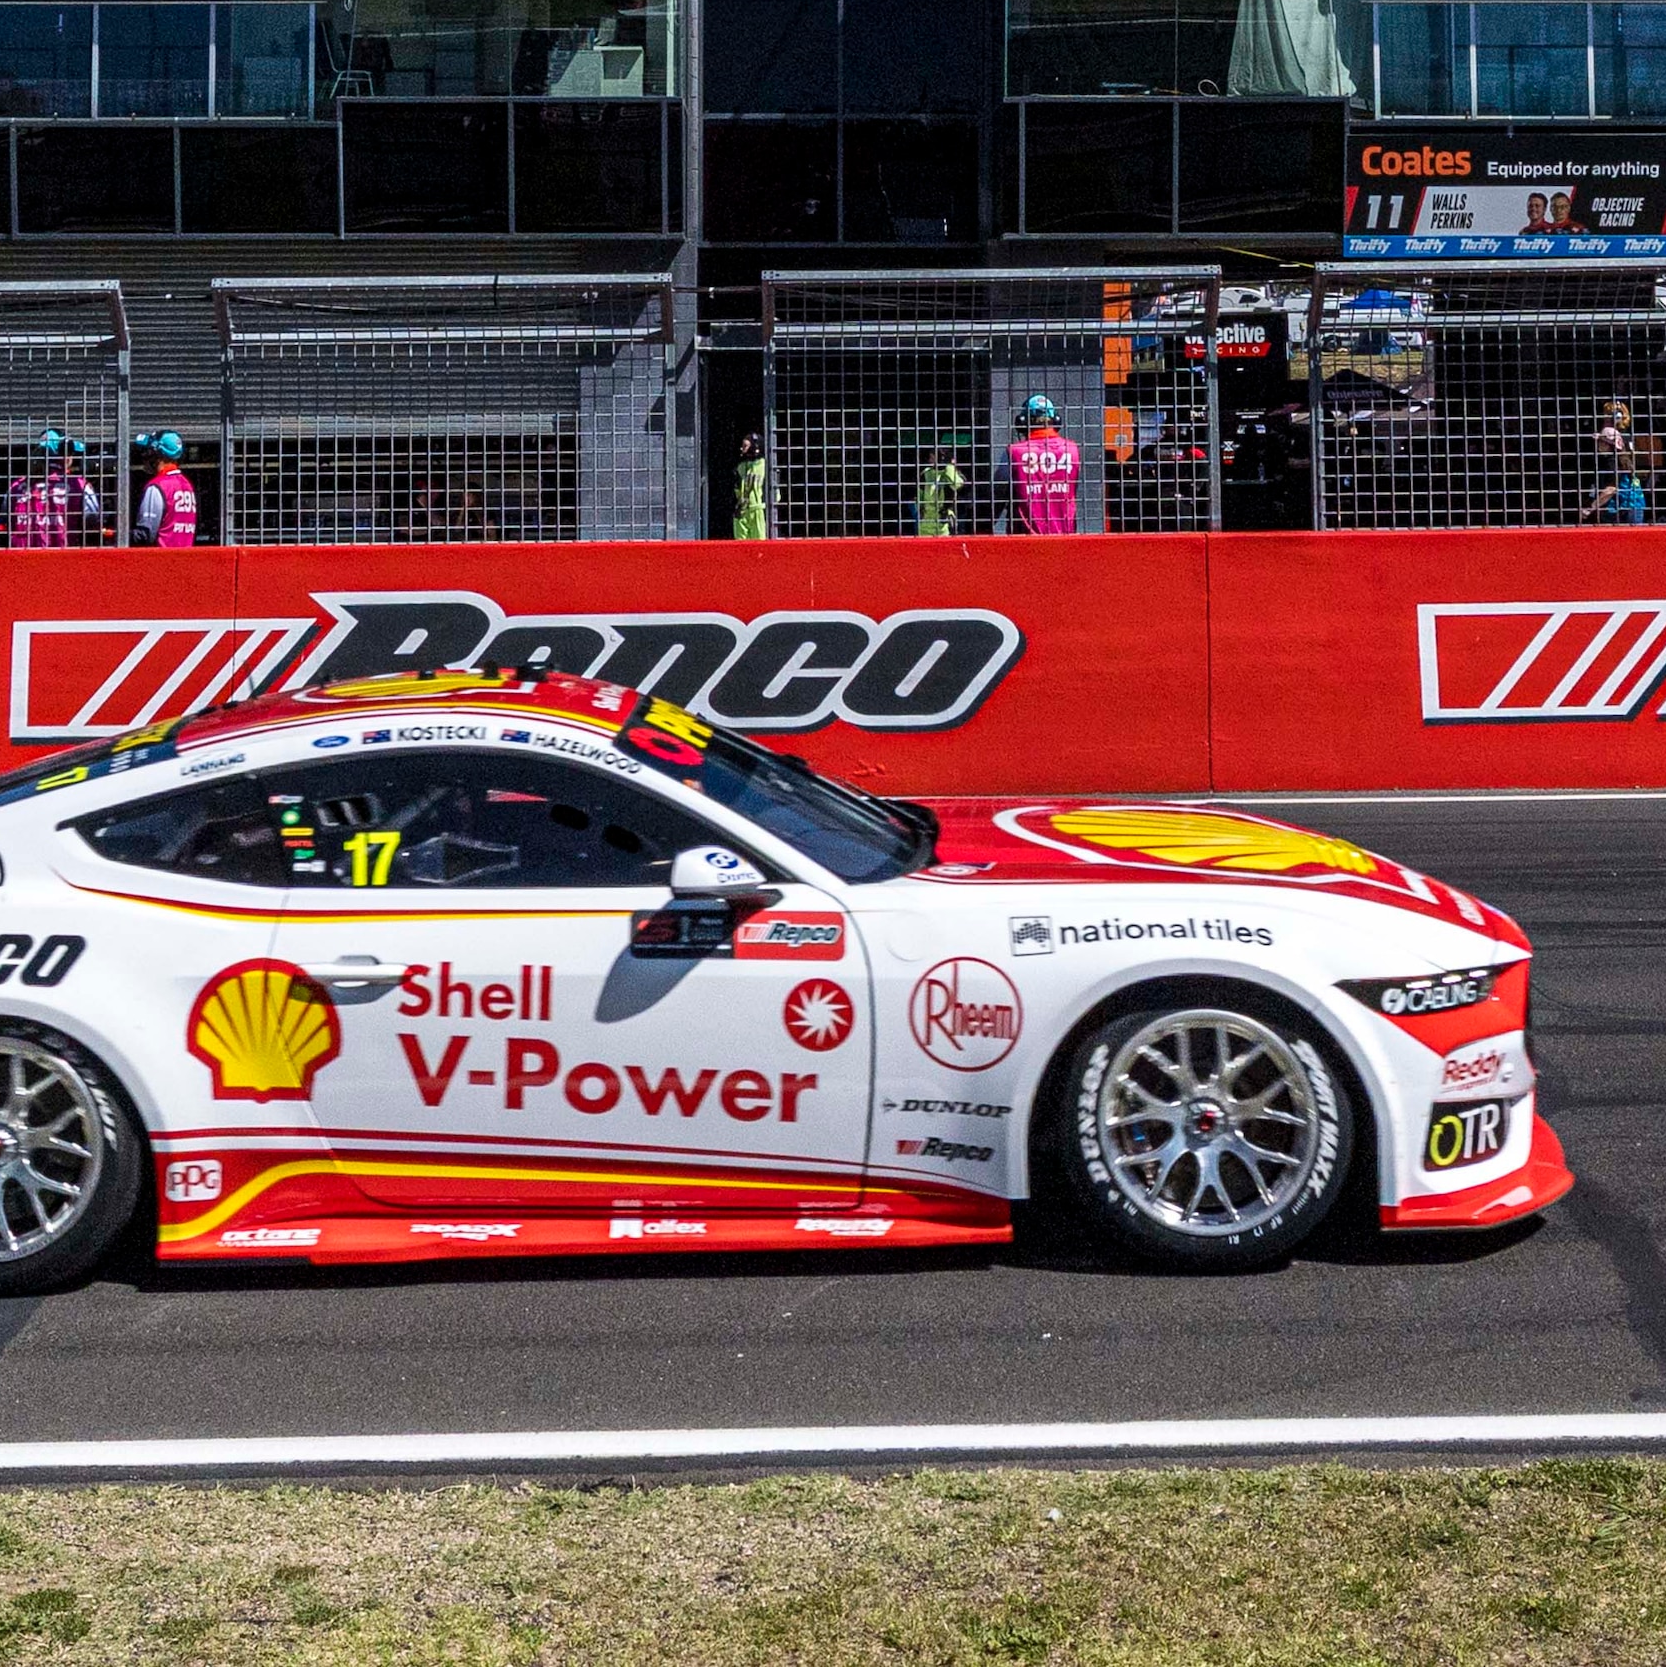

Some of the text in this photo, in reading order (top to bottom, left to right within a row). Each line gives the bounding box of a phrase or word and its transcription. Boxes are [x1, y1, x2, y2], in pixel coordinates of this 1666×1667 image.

[1362, 146, 1471, 176] Coates
[1487, 161, 1660, 178] Equipped for anything
[1366, 195, 1404, 229] 11
[1432, 193, 1467, 211] WALLS
[1591, 197, 1644, 212] OBJECTIVE
[1430, 212, 1474, 230] PERKINS
[1599, 212, 1635, 228] RACING
[1349, 238, 1665, 254] Thrifty Thrifty Thrifty Thrifty Thrifty Thrifty
[1022, 451, 1072, 474] 304
[397, 726, 486, 742] KOSTECKI
[530, 733, 640, 774] HAZELWOOD
[344, 832, 400, 886] 17
[767, 922, 840, 945] Repco
[1059, 917, 1273, 947] national tiles
[398, 961, 553, 1021] Shell
[924, 962, 1015, 1051] Rheem
[396, 1033, 819, 1123] V-Power
[902, 1099, 1013, 1118] DUNLOP
[1429, 1104, 1500, 1165] OTR
[920, 1138, 995, 1162] Repco
[169, 1165, 221, 1198] PPG
